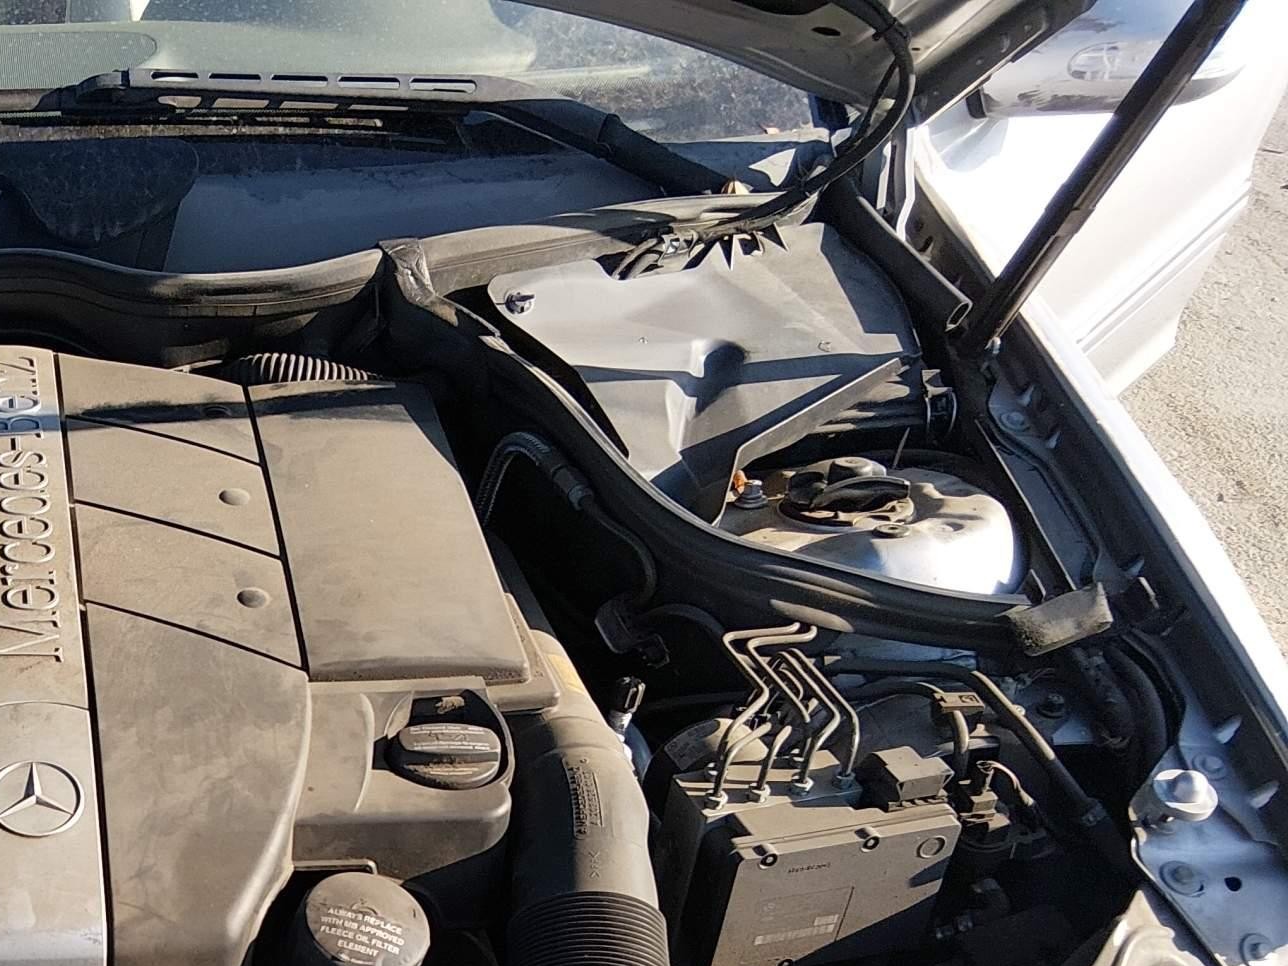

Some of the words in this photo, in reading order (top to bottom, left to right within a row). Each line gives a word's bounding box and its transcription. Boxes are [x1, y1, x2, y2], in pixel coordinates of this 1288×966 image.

[320, 916, 344, 926] WITH
[359, 925, 405, 946] APPROVED
[327, 908, 363, 920] ALWAYS
[364, 915, 403, 935] REPLACE
[320, 925, 355, 939] FLEECE
[355, 933, 370, 944] OIL
[371, 938, 400, 955] FILTER
[337, 940, 379, 957] ELEMENT
